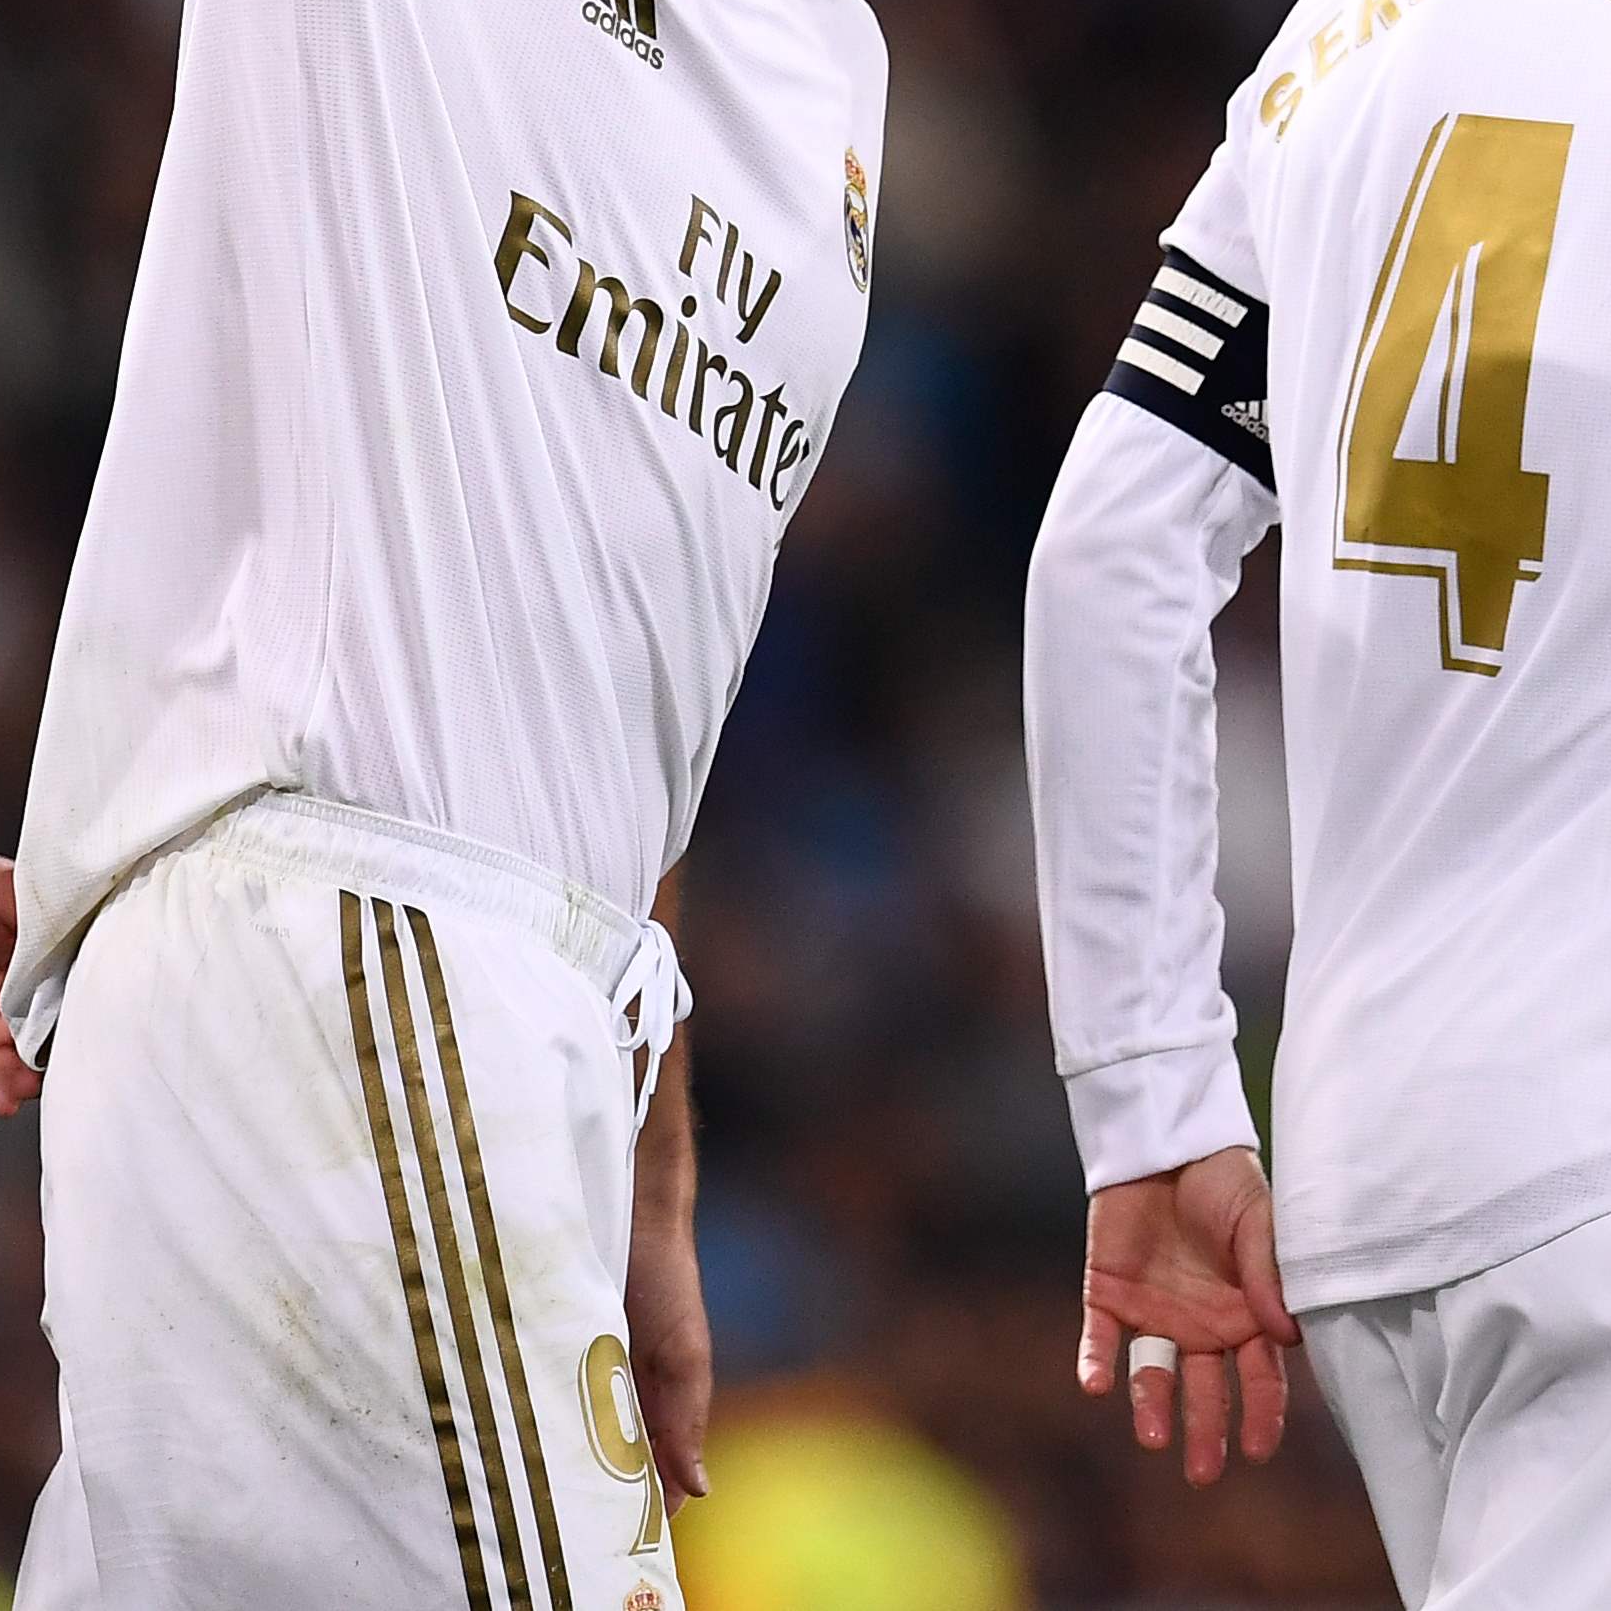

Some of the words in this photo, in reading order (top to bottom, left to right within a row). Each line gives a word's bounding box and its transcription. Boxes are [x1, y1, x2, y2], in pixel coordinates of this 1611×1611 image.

[581, 0, 665, 70] adidas
[492, 189, 811, 513] Emirate
[679, 194, 784, 345] Fly
[1333, 111, 1576, 678] 4
[576, 1333, 664, 1557] 9
